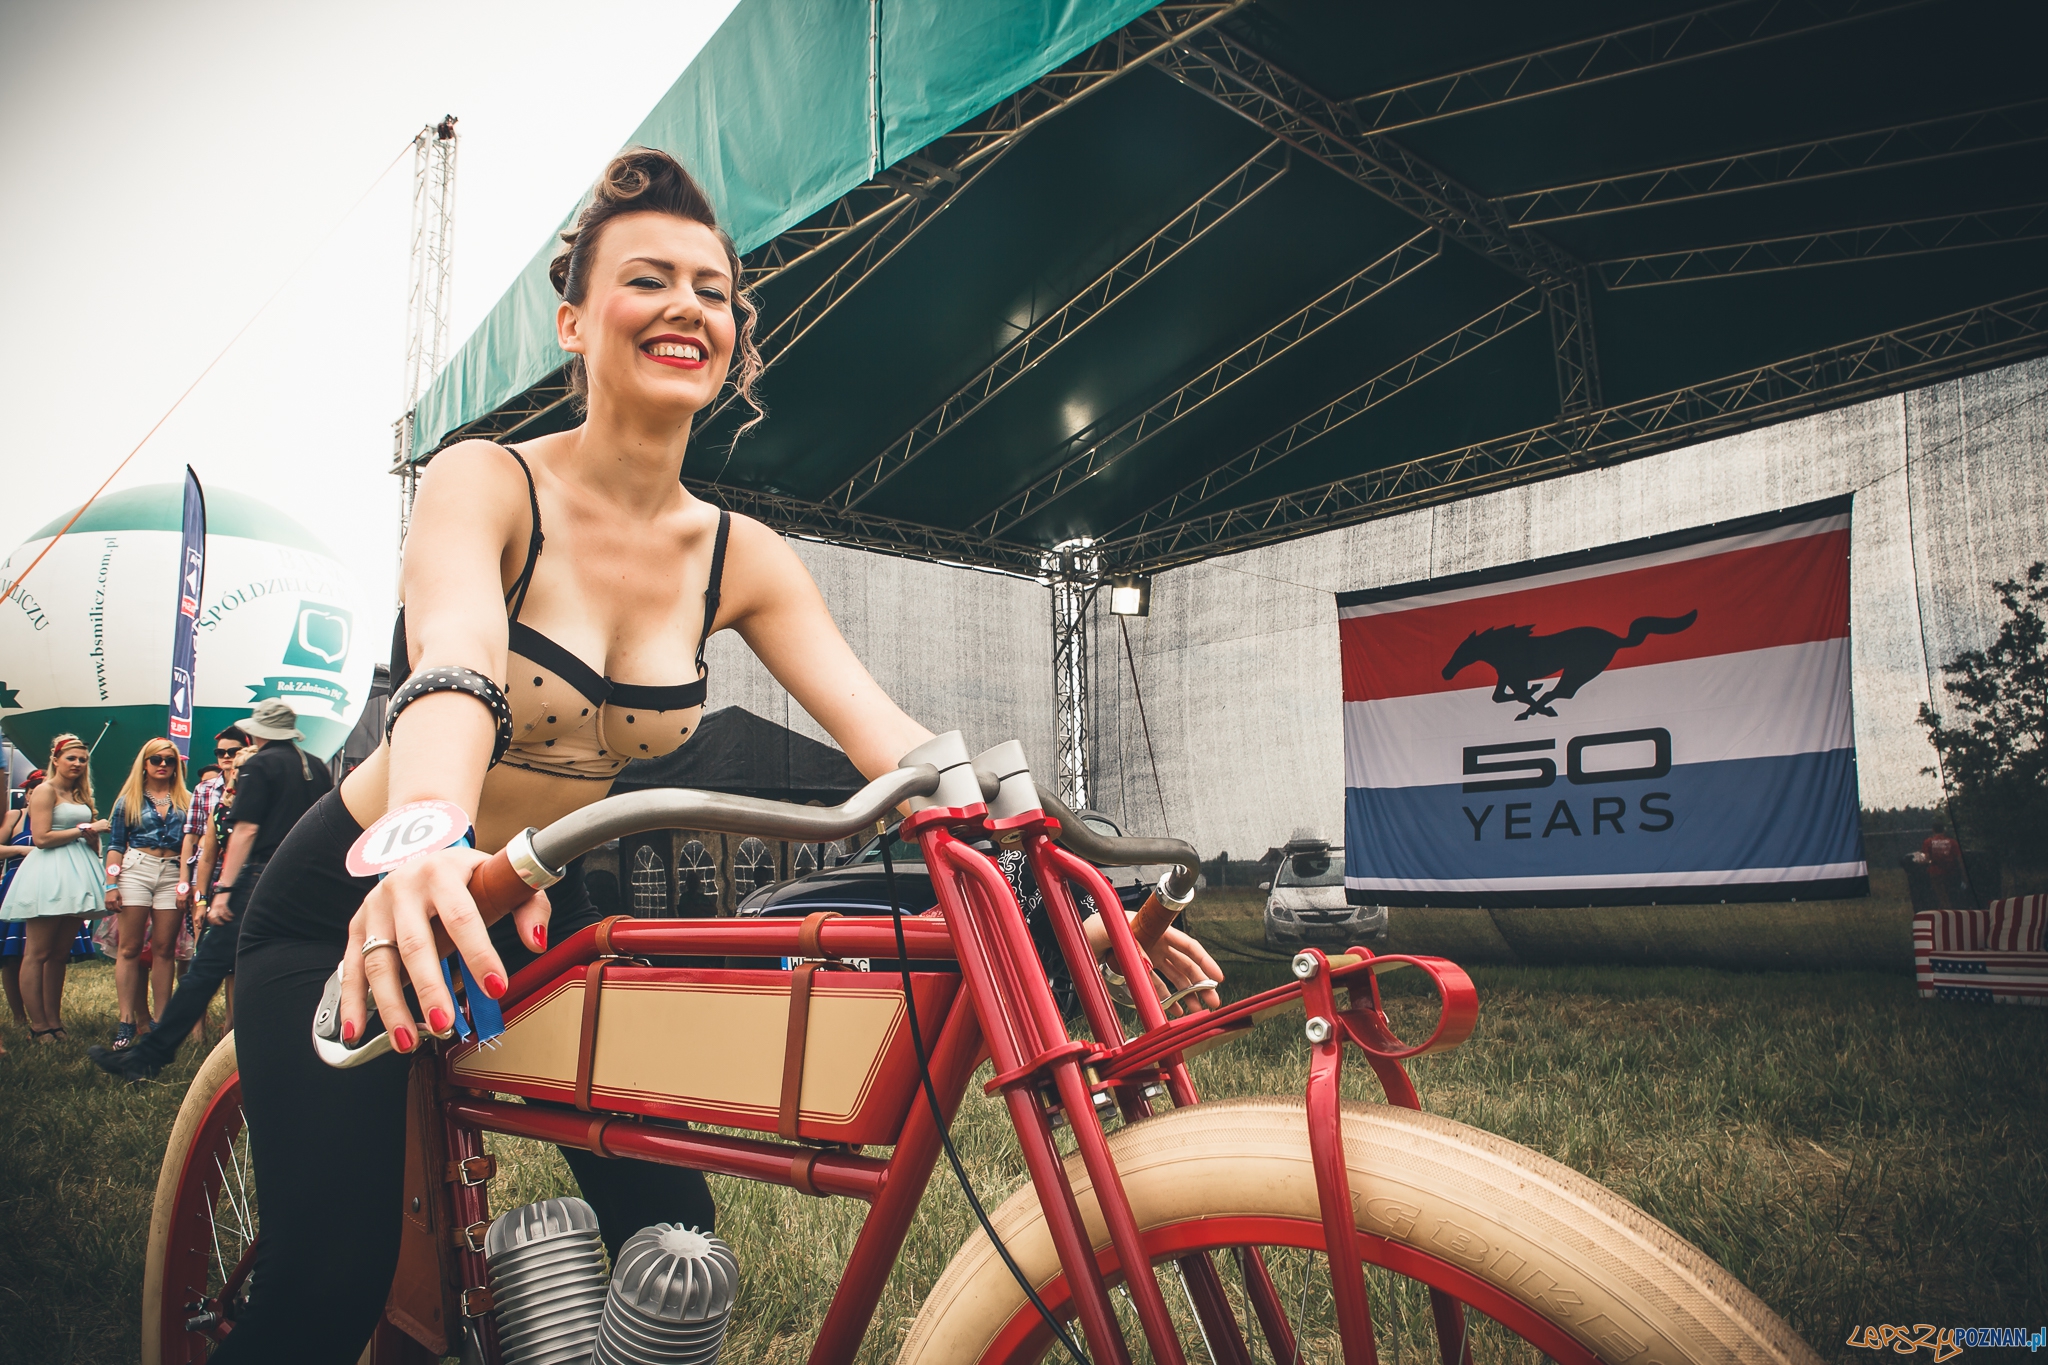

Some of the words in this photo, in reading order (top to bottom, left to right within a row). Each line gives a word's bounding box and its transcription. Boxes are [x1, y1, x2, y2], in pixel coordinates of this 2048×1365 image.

[89, 537, 119, 701] www.bsmilicz.com.pl
[1462, 727, 1672, 793] 50
[381, 814, 436, 856] 16
[1462, 791, 1675, 842] YEARS
[1350, 1188, 1664, 1365] GBIKE
